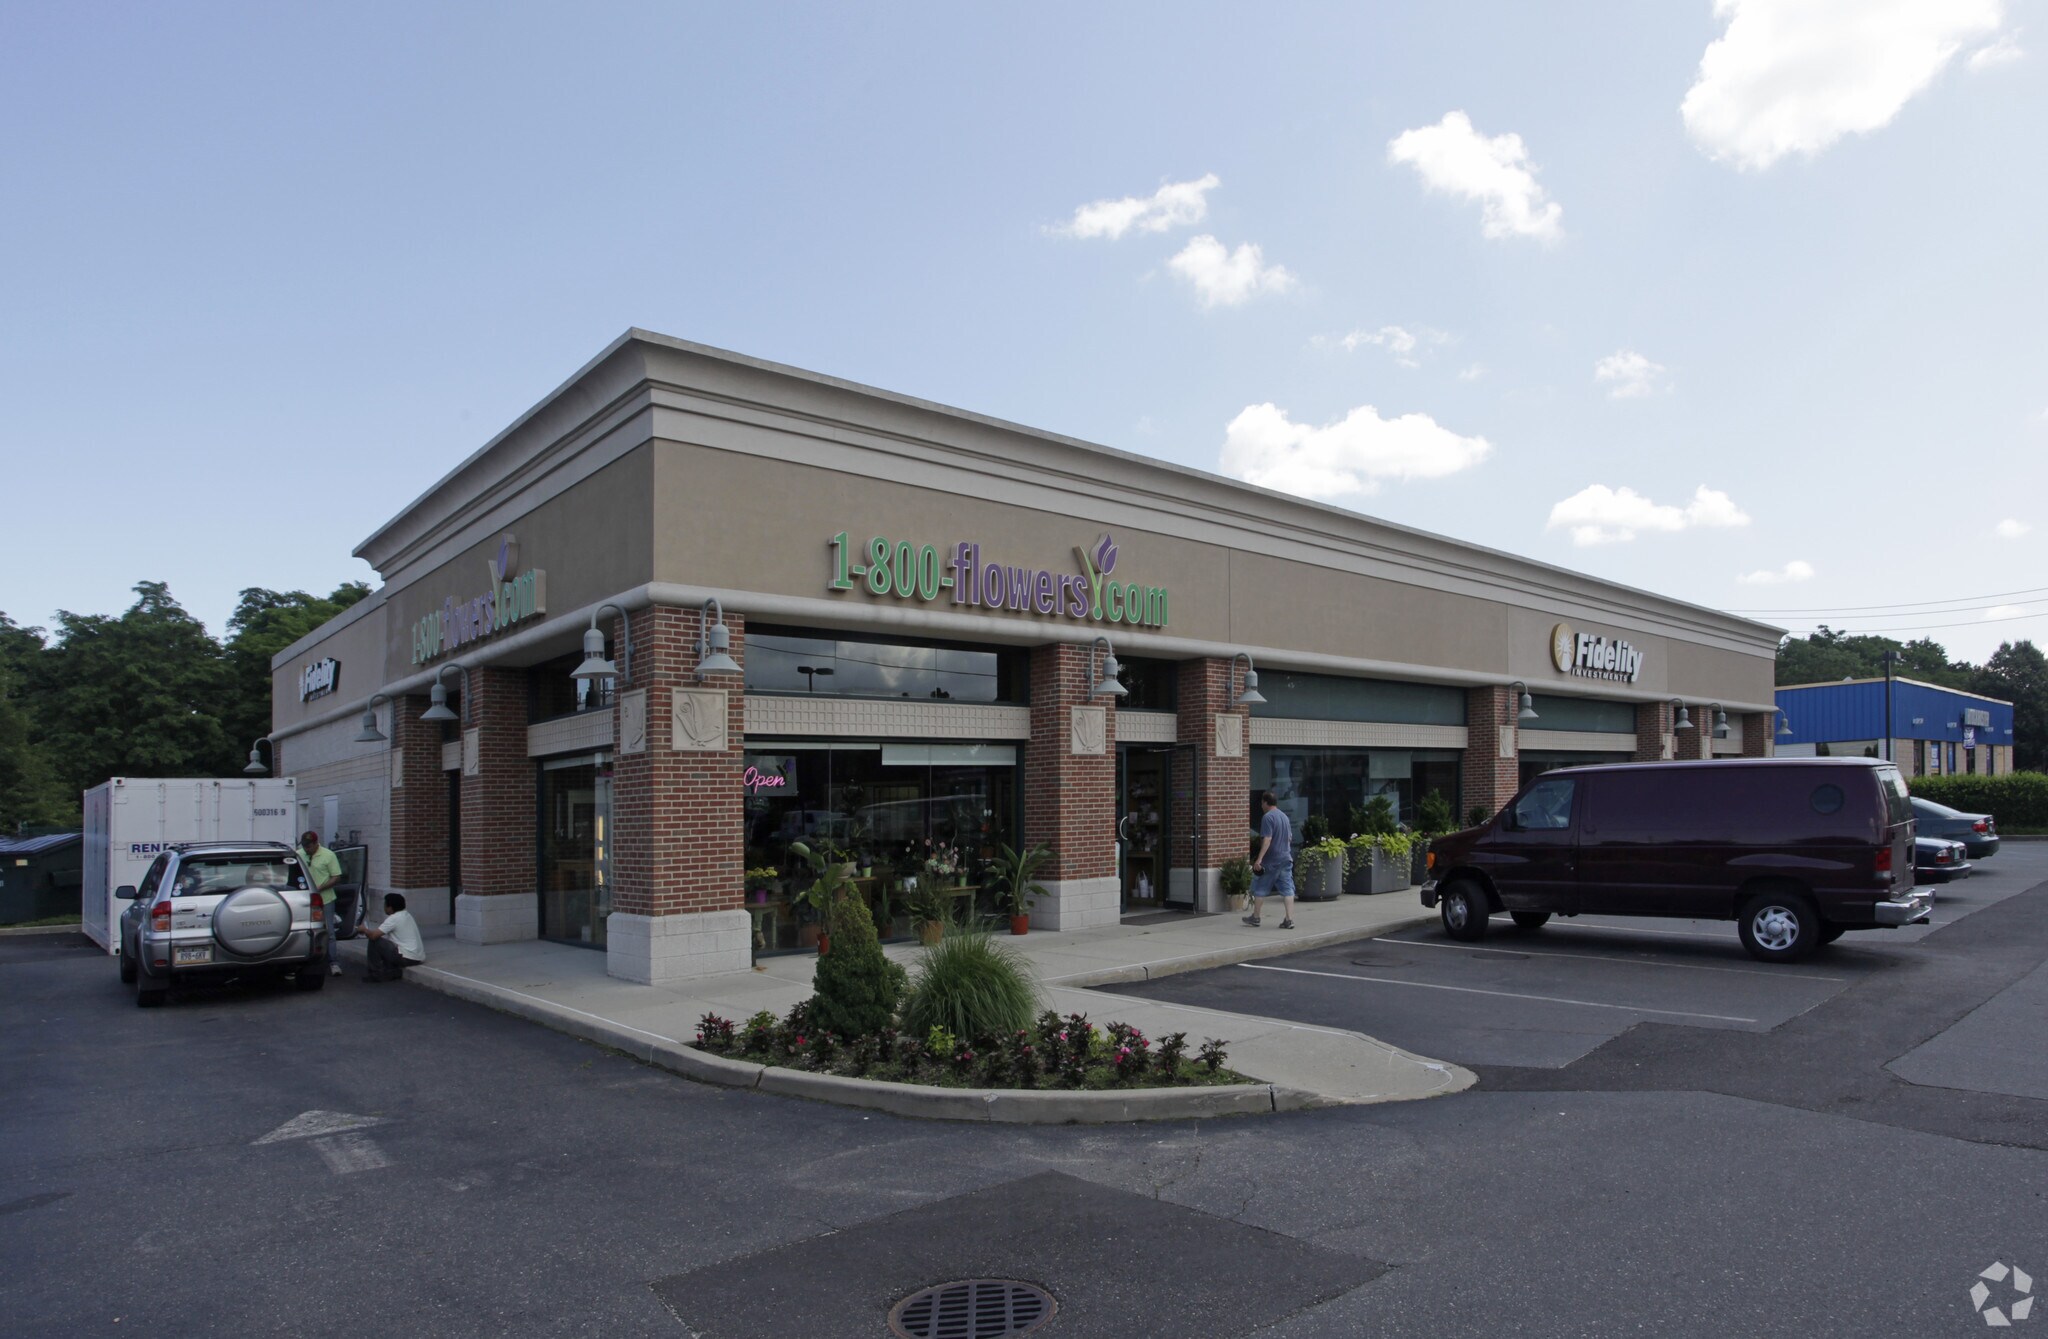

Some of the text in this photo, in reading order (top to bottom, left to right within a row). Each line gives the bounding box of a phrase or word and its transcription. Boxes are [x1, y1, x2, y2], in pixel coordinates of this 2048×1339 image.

[1575, 632, 1643, 682] Fidelity
[1571, 667, 1629, 682] INVESTMENTS
[743, 766, 786, 794] Open
